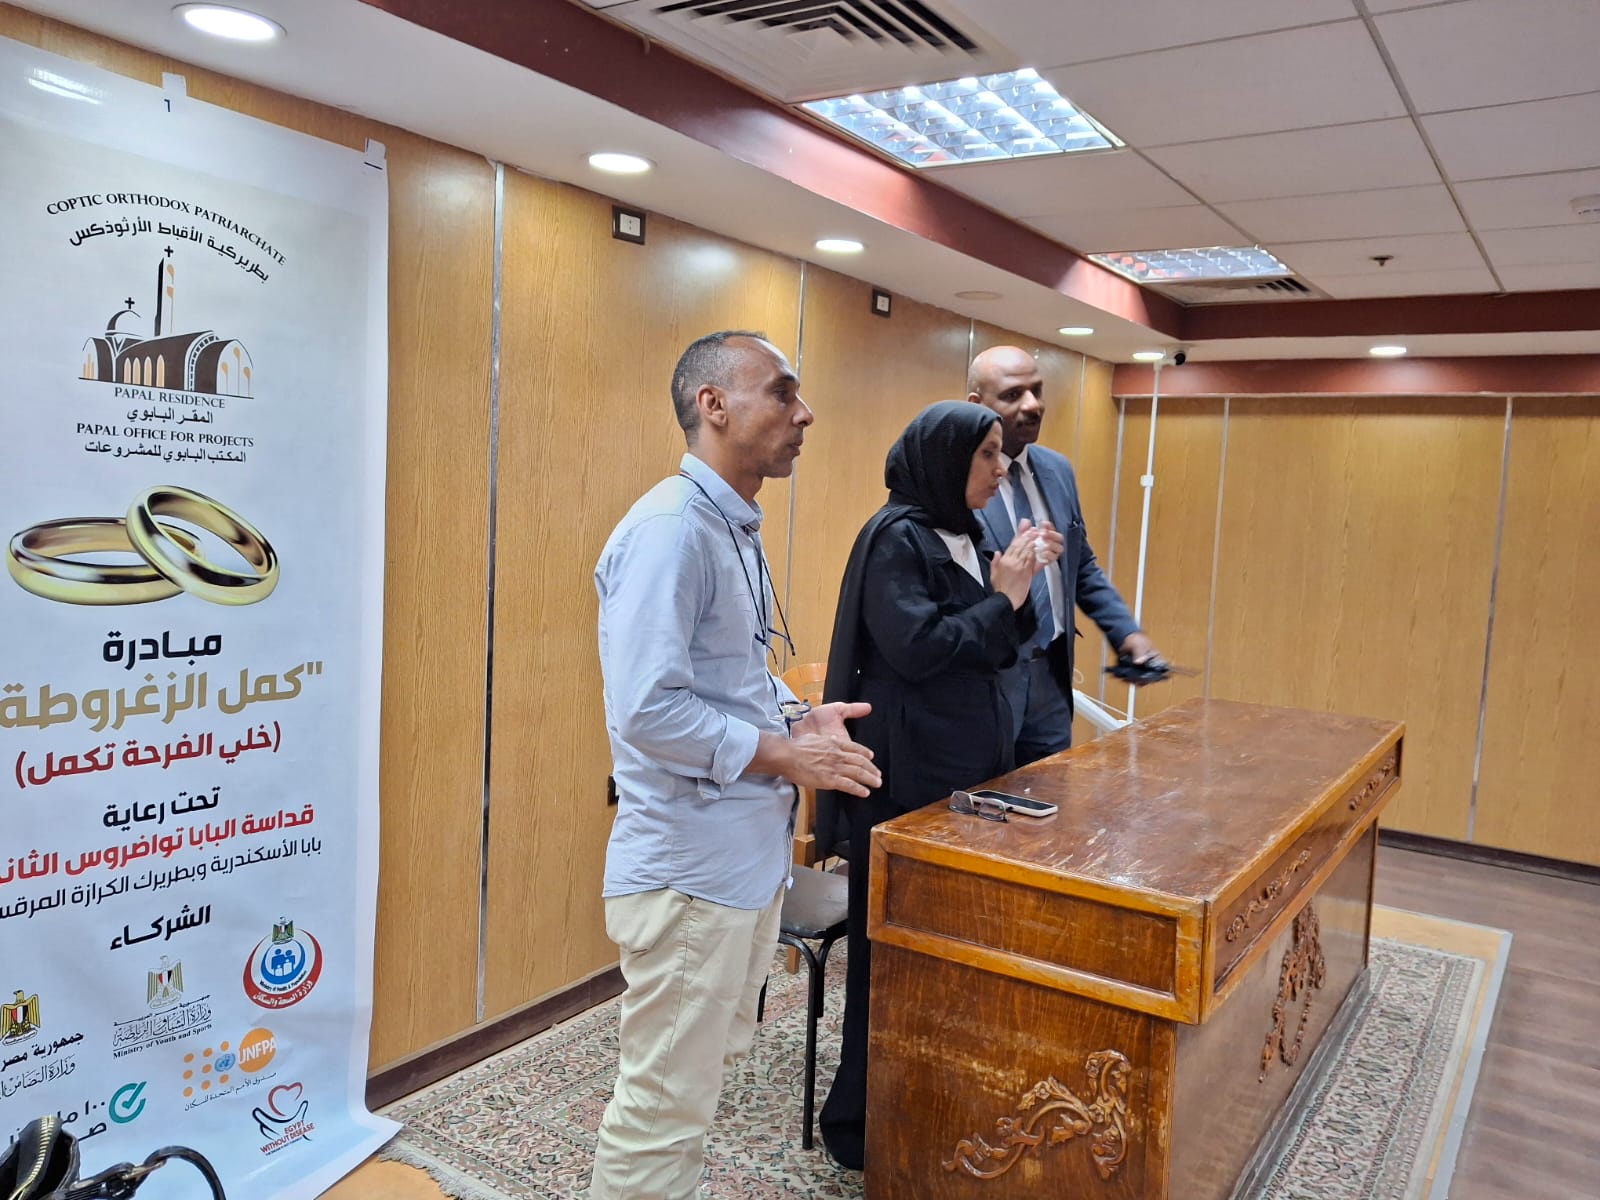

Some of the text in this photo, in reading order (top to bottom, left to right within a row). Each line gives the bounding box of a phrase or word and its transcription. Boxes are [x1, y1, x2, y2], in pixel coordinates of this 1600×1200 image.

[47, 193, 287, 266] COPTIC ORTHODOX PATRIARCHATE
[69, 216, 269, 284] بطريركية الأقباط الأرثوذكس
[114, 387, 226, 409] PAPAL RESIDENCE
[127, 406, 213, 424] المقر البابوي
[76, 423, 254, 447] PAPAL OFFICE FOR PROJECTS
[85, 441, 246, 464] المكتب البابوي للمشروعات
[103, 630, 222, 670] مبادرة
[0, 672, 207, 732] الزغروطة
[122, 733, 213, 769] الفرحة
[103, 786, 221, 832] تحت رعاية
[0, 804, 314, 884] قداسة البابا تواضروس الثان
[300, 837, 322, 855] بابا
[71, 875, 129, 908] الكرازة
[133, 861, 207, 892] وبطريرك
[0, 889, 65, 919] المرقس
[109, 904, 211, 951] الشركاء
[31, 1032, 84, 1059] جمهورية
[113, 1024, 212, 1059] Ministry of Youth and Sports
[239, 1037, 277, 1064] UNFPA
[0, 1052, 28, 1072] مصر
[260, 1135, 290, 1153] WITHOUT
[290, 1123, 315, 1139] DISEASE
[284, 1120, 304, 1134] EGYPT
